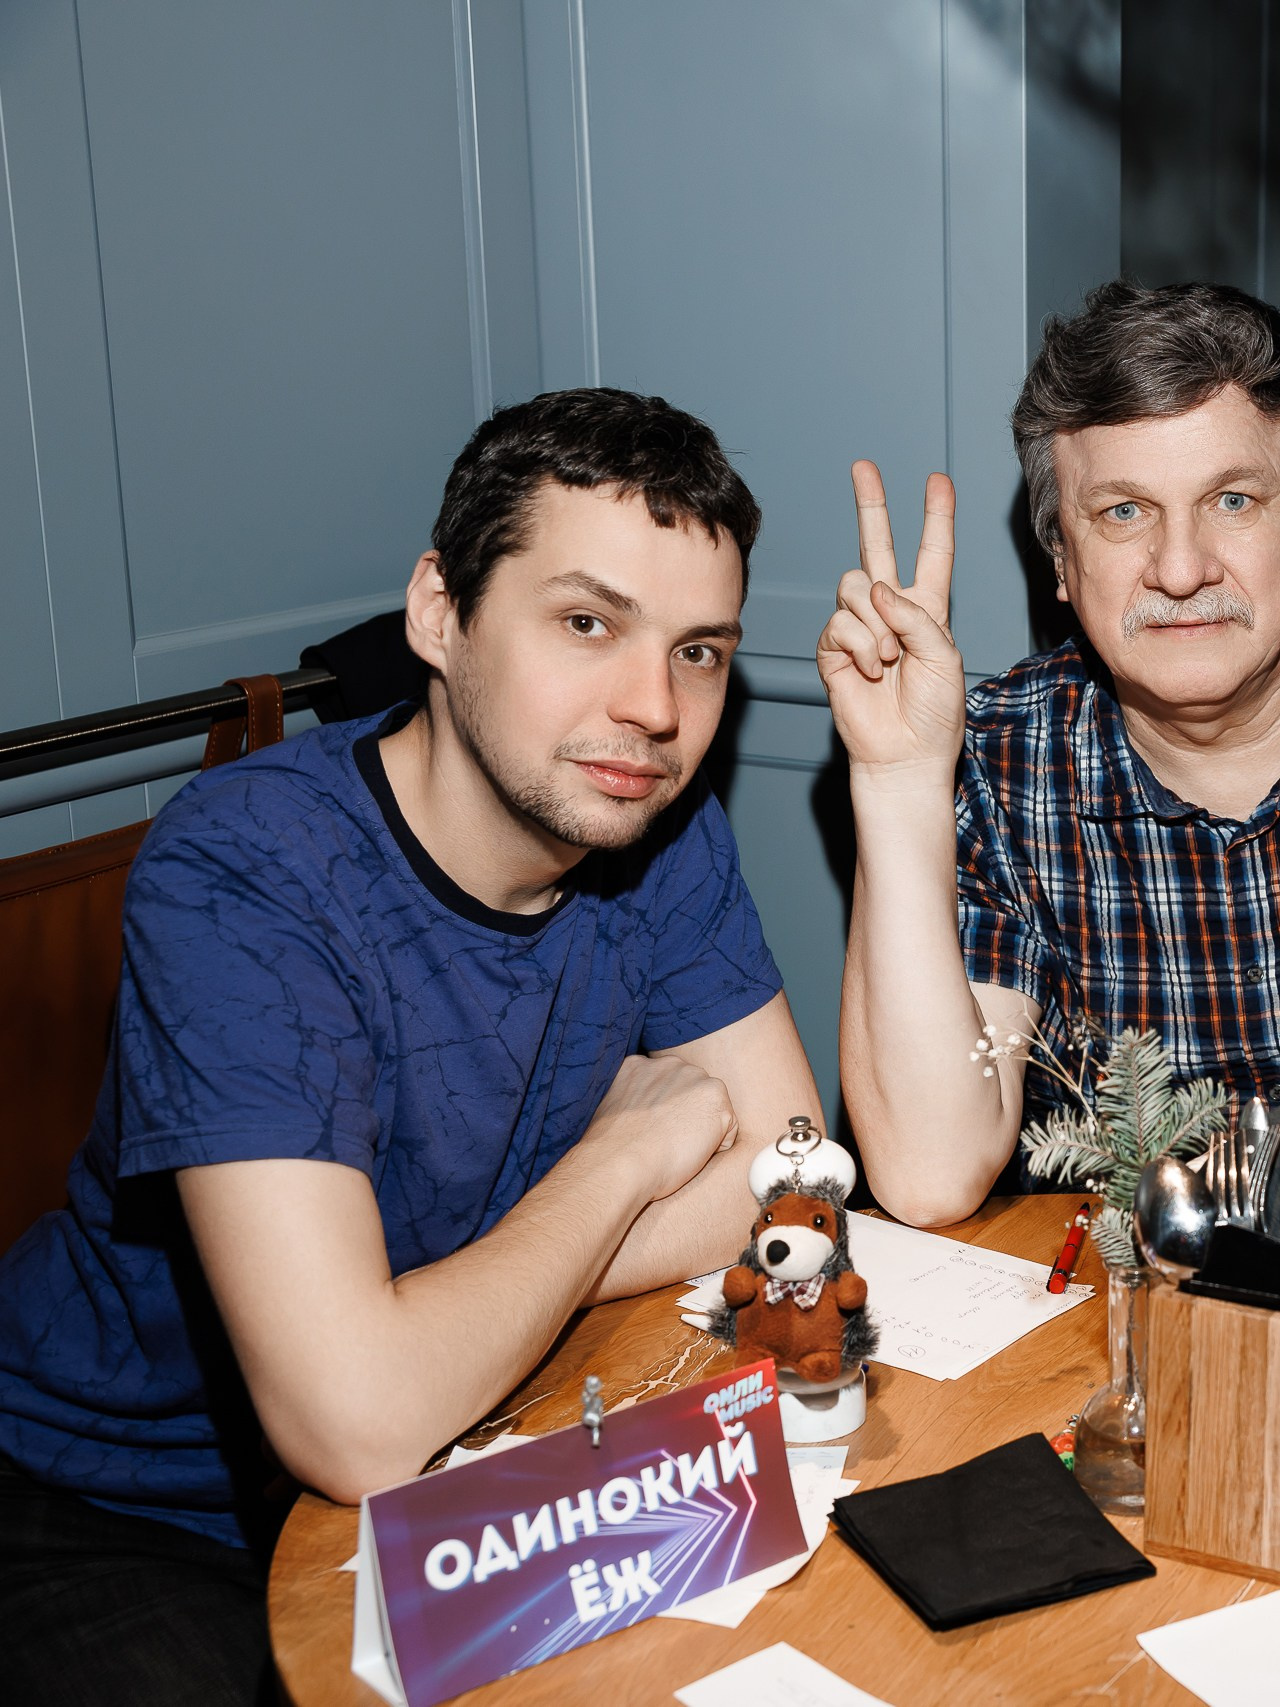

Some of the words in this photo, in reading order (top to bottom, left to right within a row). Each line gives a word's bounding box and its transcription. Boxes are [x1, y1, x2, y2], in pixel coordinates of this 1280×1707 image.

[718, 1385, 775, 1424] MUSIC
[424, 1422, 760, 1592] ОДИНОКИЙ
[567, 1549, 664, 1625] ЁЖ
